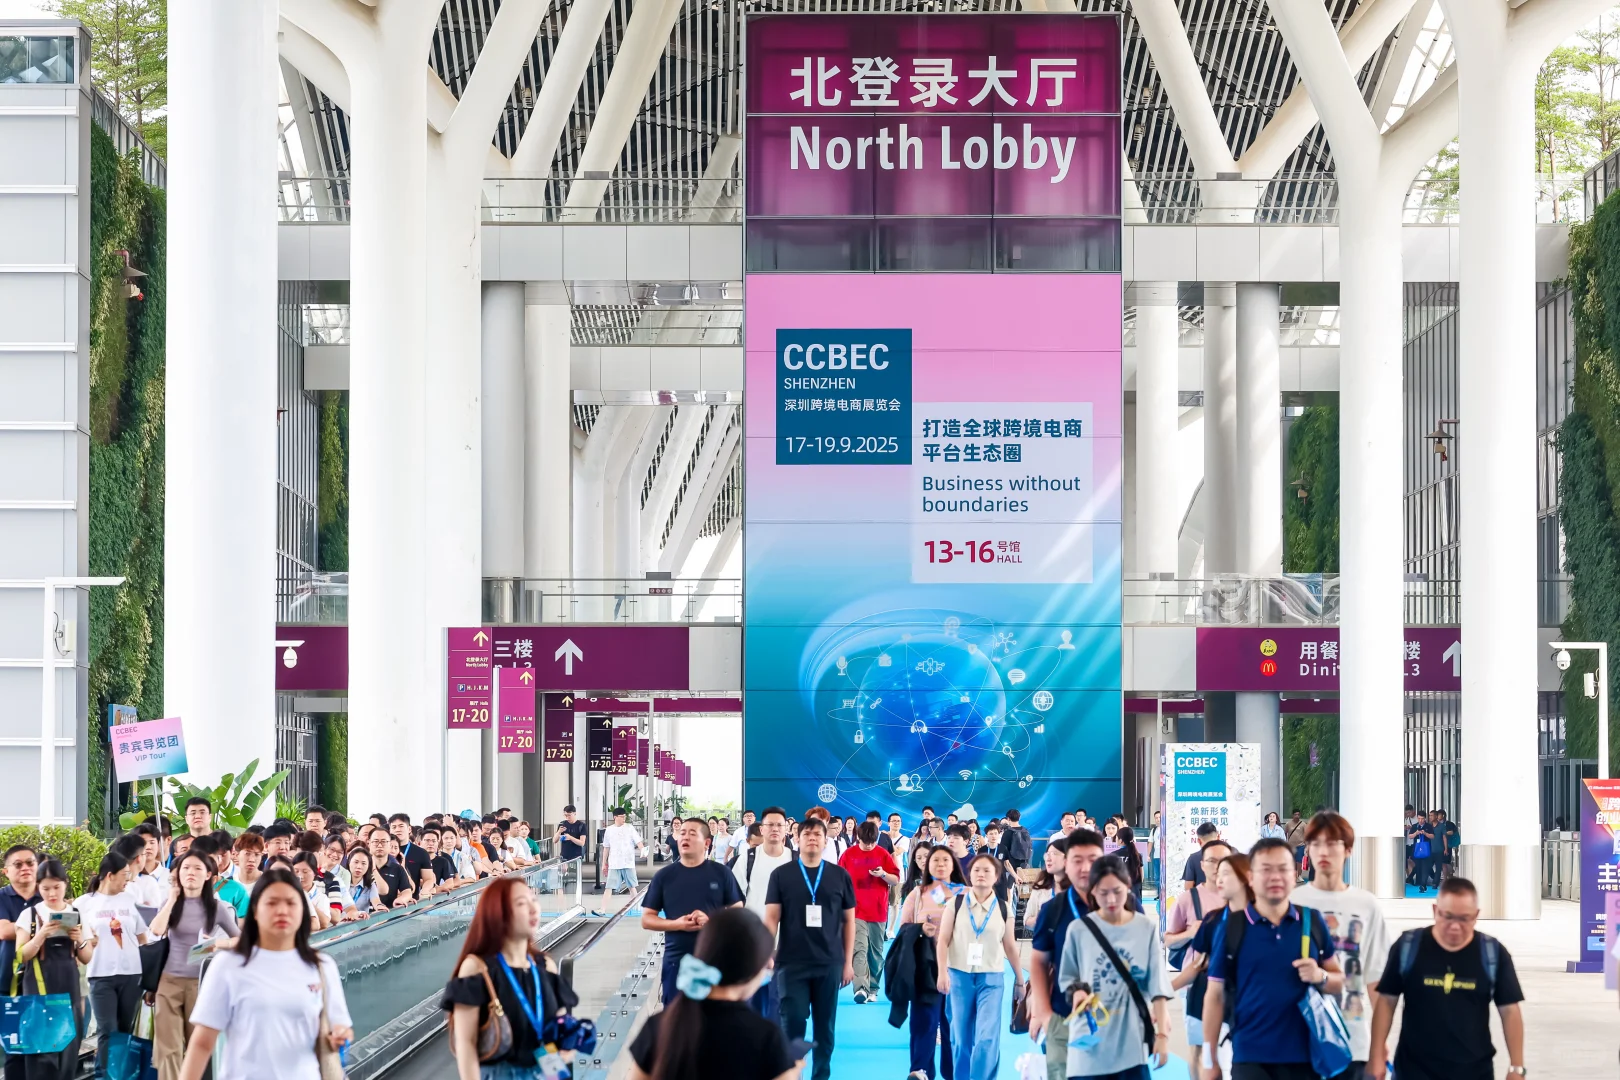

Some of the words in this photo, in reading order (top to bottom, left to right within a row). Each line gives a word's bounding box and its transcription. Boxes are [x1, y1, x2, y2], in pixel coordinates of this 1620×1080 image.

[789, 55, 1078, 107] 北登录大厅
[790, 123, 923, 170] North
[941, 123, 1077, 184] Lobby
[783, 343, 889, 370] CCBEC
[783, 377, 856, 390] SHENZHEN
[784, 398, 901, 412] 深圳跨境电商展览会
[922, 418, 1082, 438] 打造全球跨境电商
[785, 436, 899, 453] 17-19.9.2025
[922, 443, 1022, 463] 平台生态圈
[922, 476, 1003, 491] Business
[1009, 476, 1080, 491] without
[922, 496, 1029, 512] boundaries
[924, 540, 995, 563] 13-16
[997, 541, 1020, 552] 号馆
[997, 554, 1022, 563] HALL
[1300, 641, 1338, 659] 用餐
[453, 708, 488, 722] 17-20
[119, 735, 179, 755] 贵宾导览团
[501, 736, 533, 748] 17-20
[135, 754, 148, 762] VIP
[149, 752, 166, 760] Tour
[546, 748, 572, 759] 17-20
[590, 760, 611, 768] 17-20
[1177, 757, 1217, 768] CCBEC
[1190, 807, 1228, 815] 焕新形象
[1190, 817, 1228, 826] 明年再见
